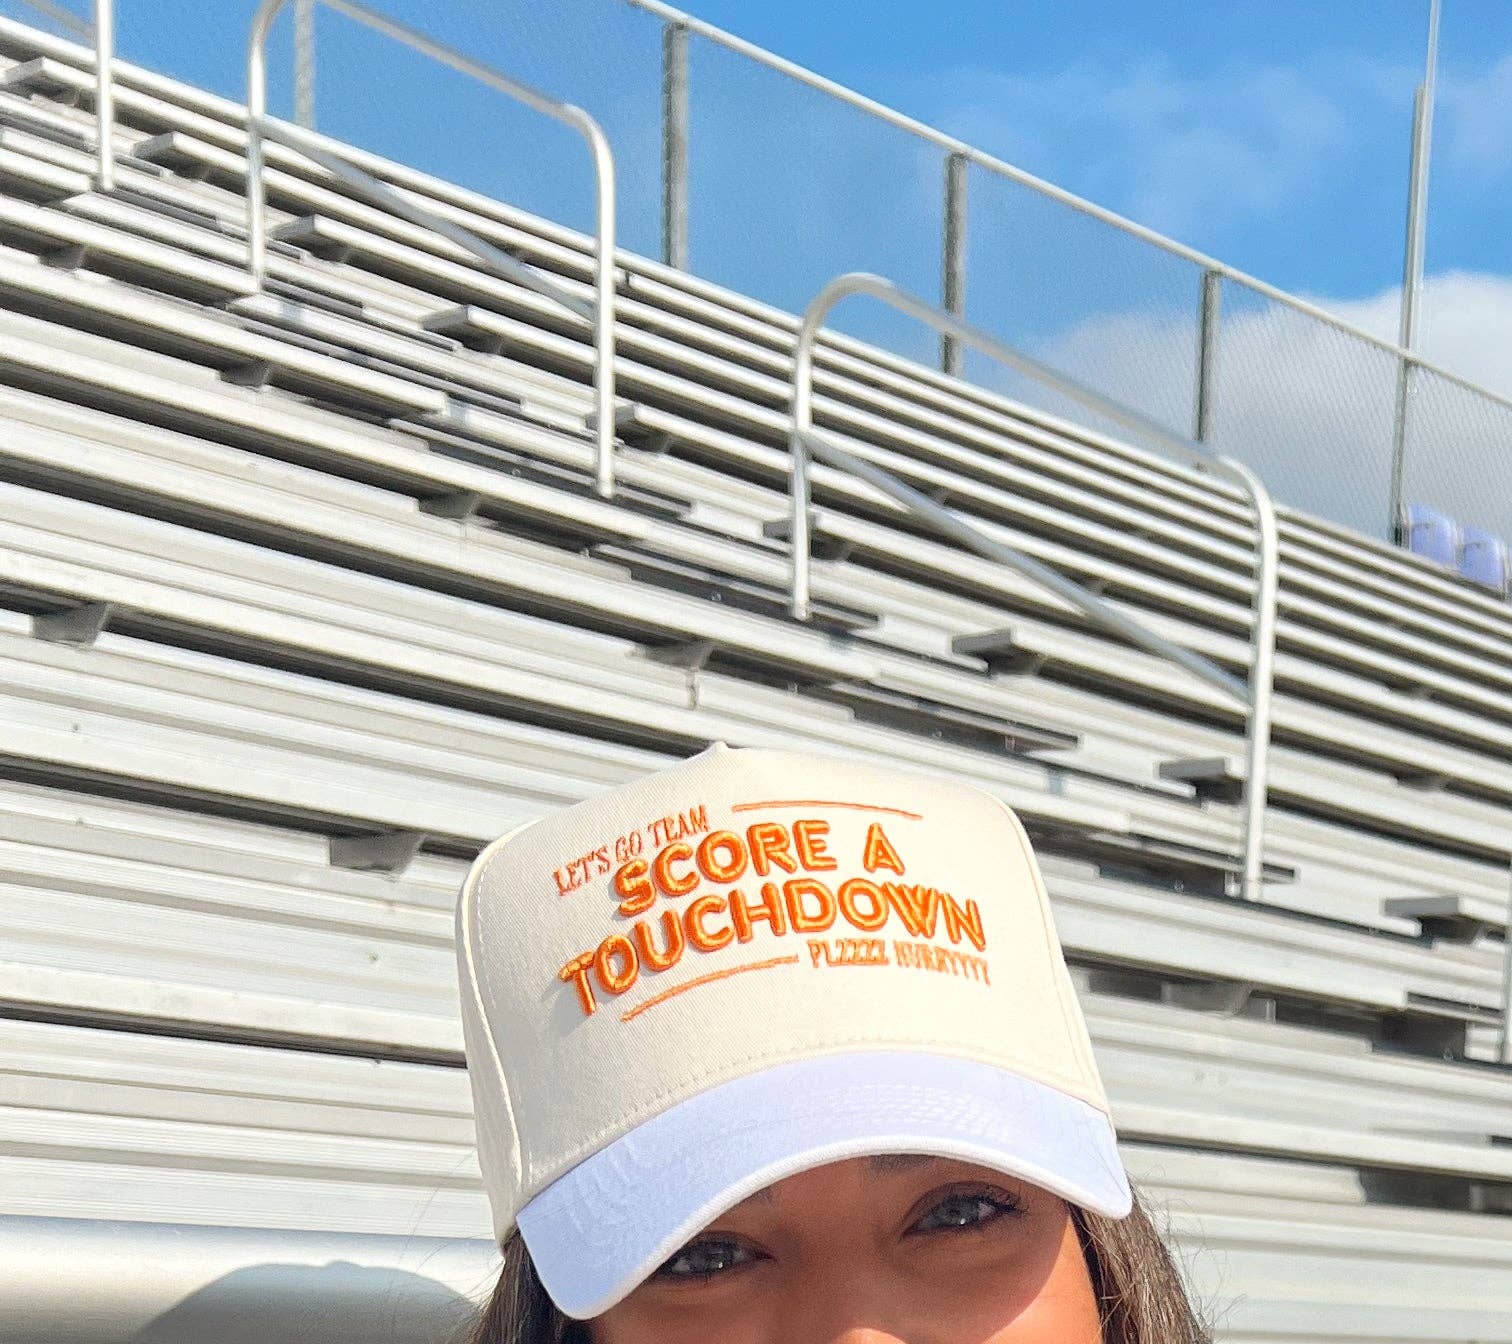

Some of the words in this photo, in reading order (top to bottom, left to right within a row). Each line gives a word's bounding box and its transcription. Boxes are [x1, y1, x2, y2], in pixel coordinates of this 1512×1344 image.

[553, 843, 611, 896] LET'S
[615, 829, 643, 863] GO
[648, 804, 709, 848] TEAM
[615, 819, 838, 916] SCORE
[864, 822, 905, 875] A
[559, 877, 986, 1016] TOUCHDOWN
